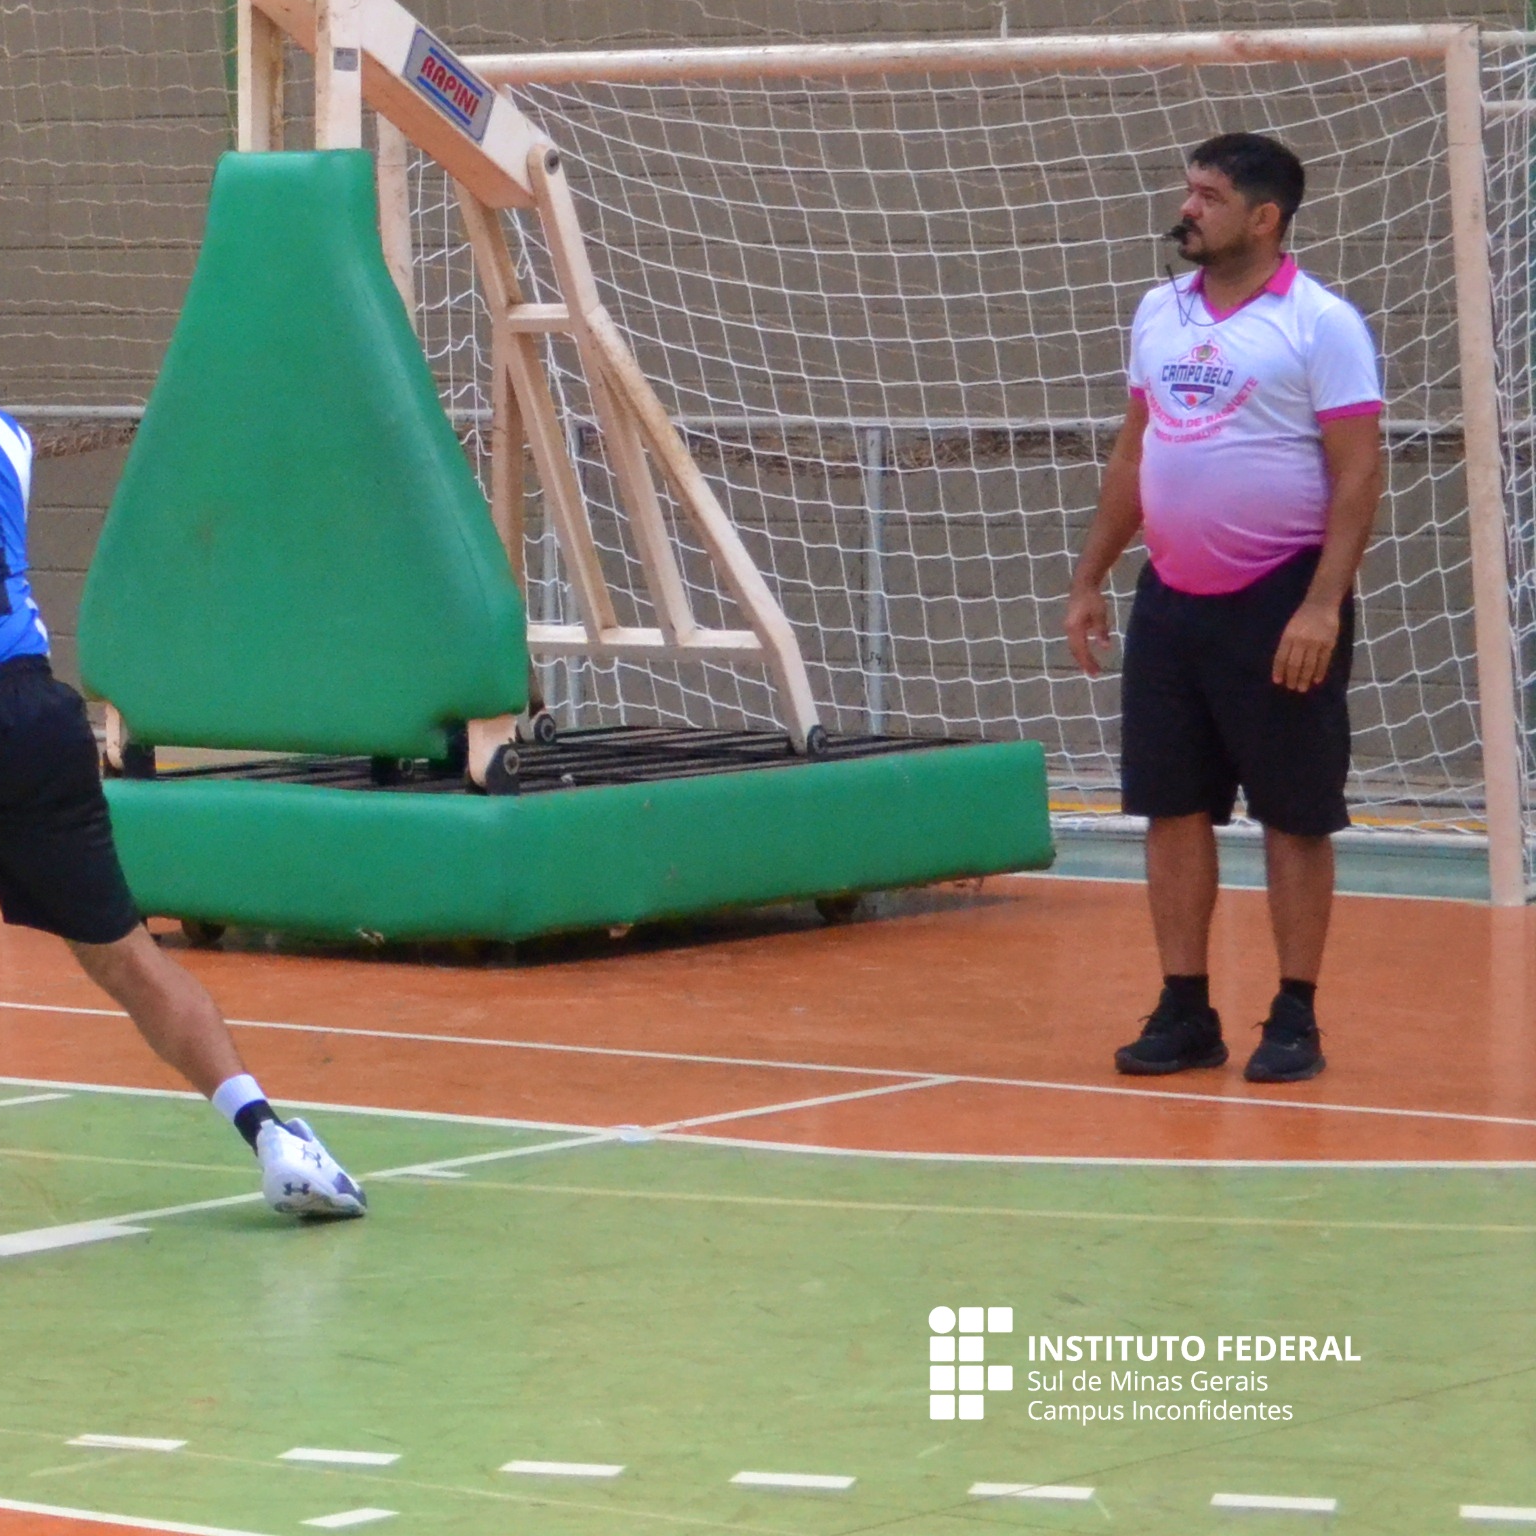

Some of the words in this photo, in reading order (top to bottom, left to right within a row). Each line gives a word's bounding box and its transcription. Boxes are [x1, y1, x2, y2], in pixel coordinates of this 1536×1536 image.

[420, 55, 480, 118] RAPINI
[1161, 364, 1203, 382] CAMPO
[1202, 366, 1234, 387] BELO
